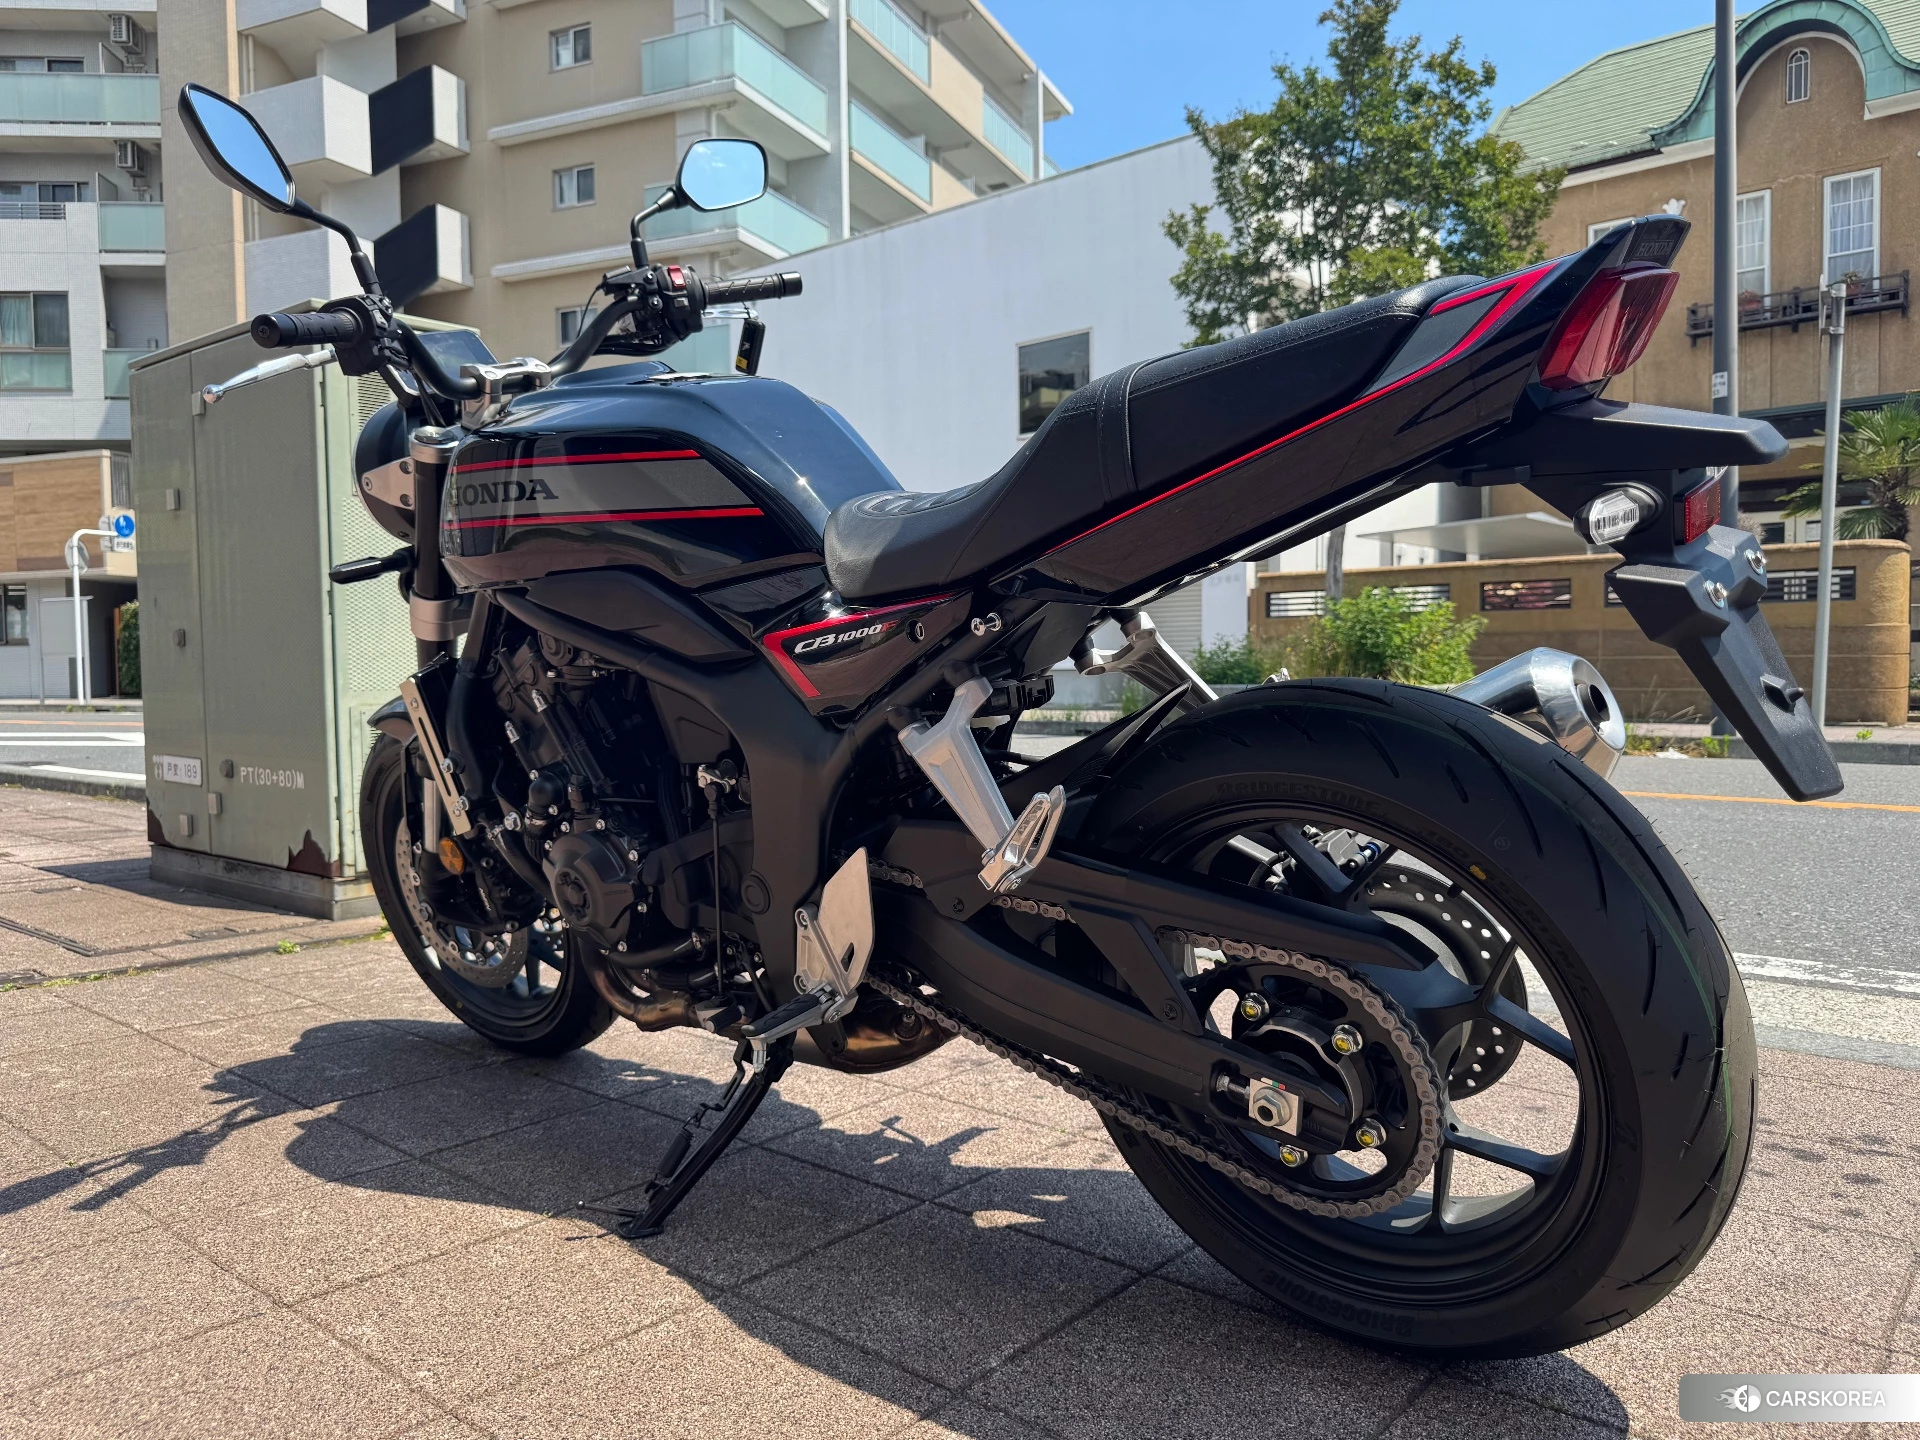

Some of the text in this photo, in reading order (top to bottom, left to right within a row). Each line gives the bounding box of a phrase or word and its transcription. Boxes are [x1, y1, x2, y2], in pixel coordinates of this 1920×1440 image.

[794, 619, 899, 654] CB1000F
[184, 763, 197, 779] 189
[240, 766, 305, 790] PT(30+80)M
[1216, 780, 1382, 812] BRIDGESTONE
[1261, 1268, 1415, 1338] BRIDGESTONE
